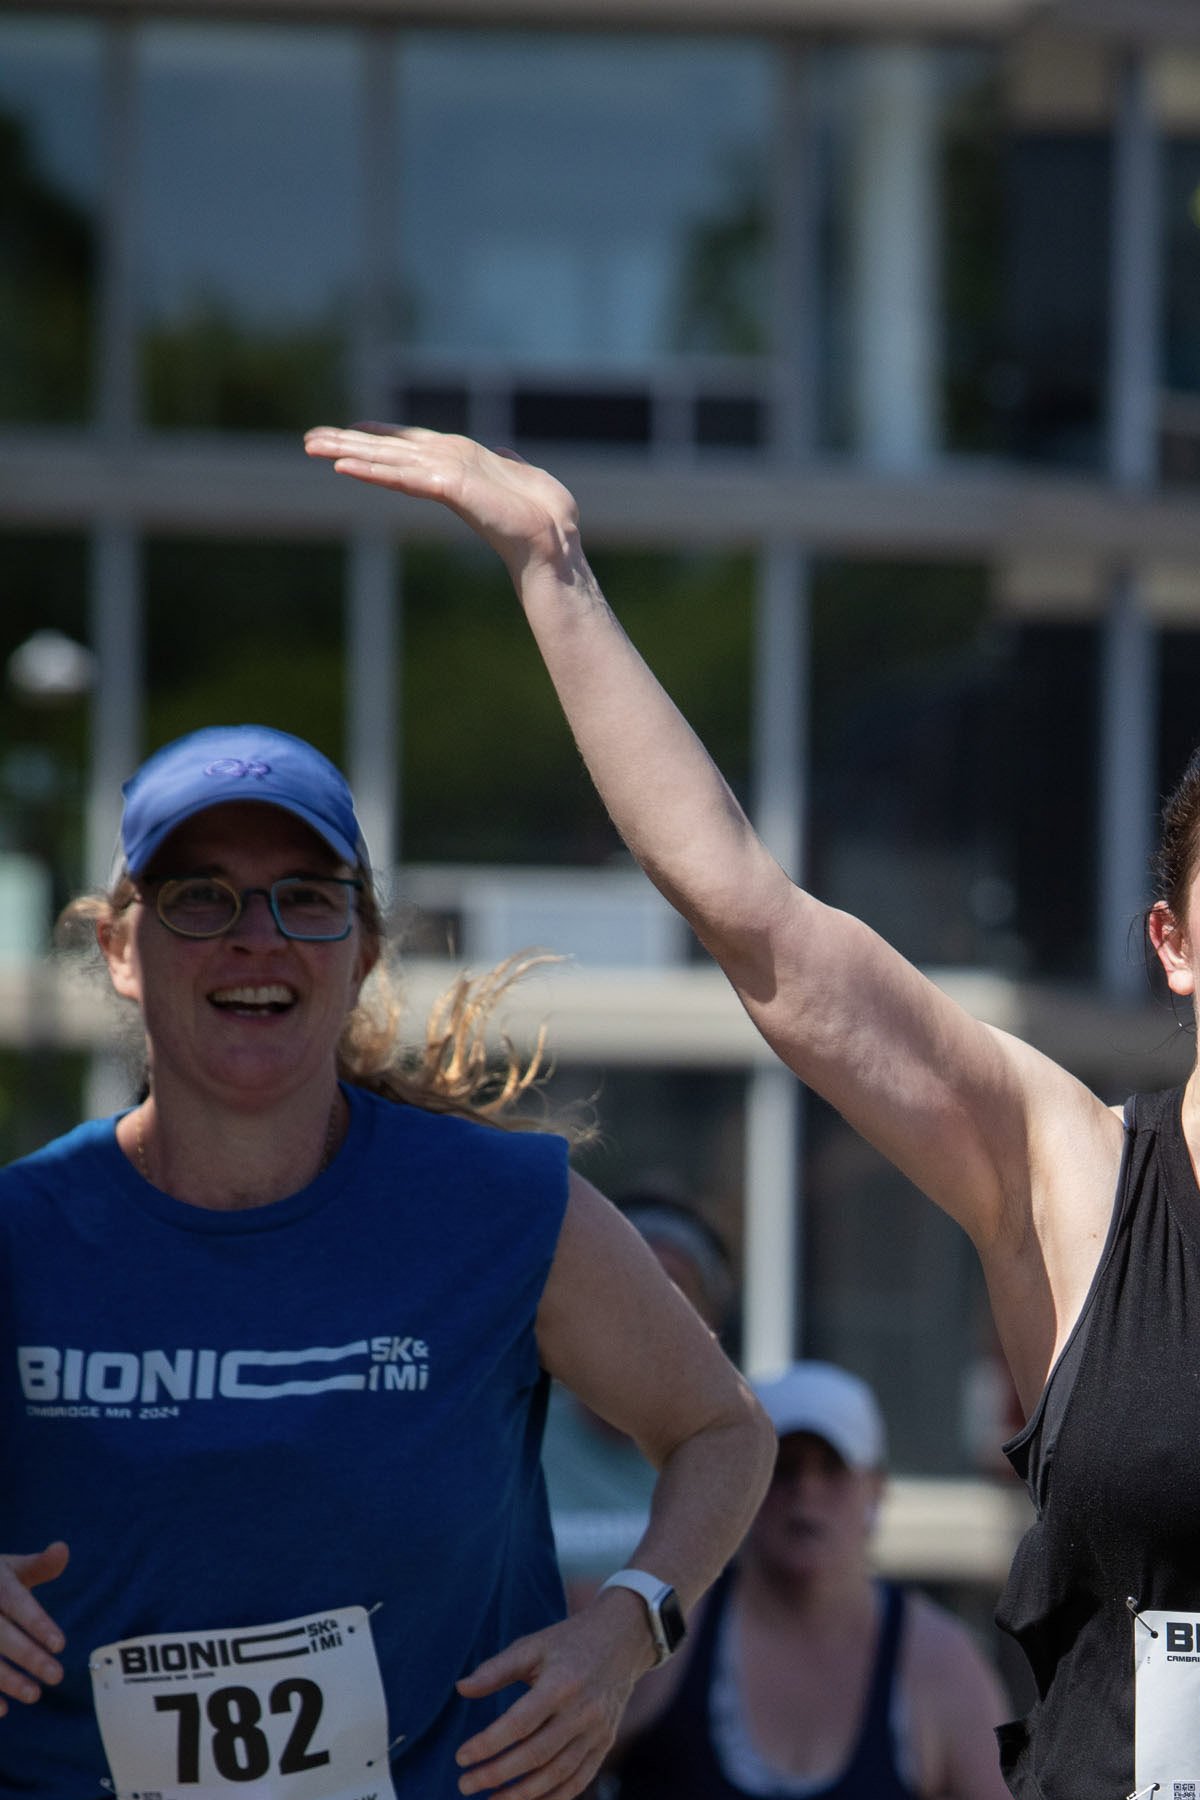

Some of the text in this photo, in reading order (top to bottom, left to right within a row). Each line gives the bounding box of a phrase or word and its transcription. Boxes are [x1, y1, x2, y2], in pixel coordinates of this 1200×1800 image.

[17, 1340, 368, 1403] BIONIC
[118, 1626, 311, 1675] BIONIC
[153, 1677, 330, 1784] 782
